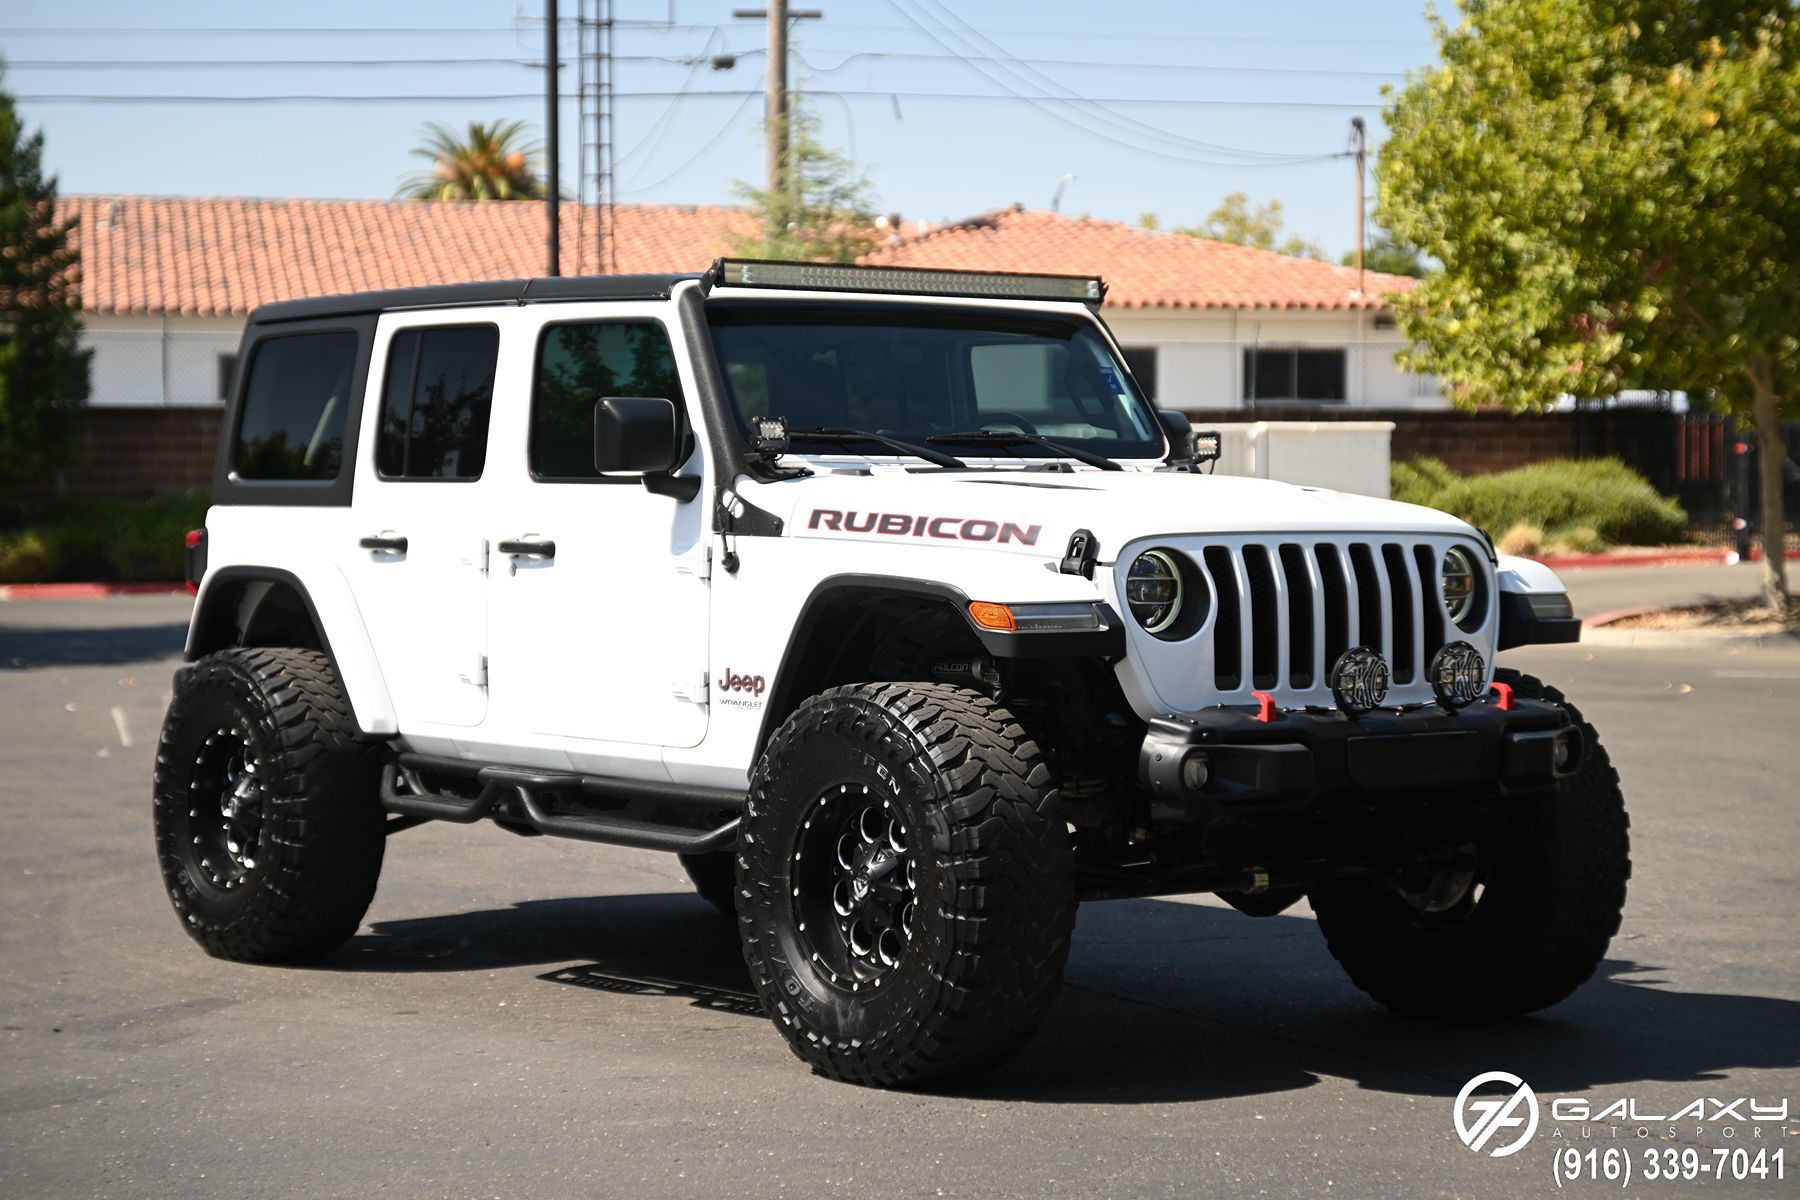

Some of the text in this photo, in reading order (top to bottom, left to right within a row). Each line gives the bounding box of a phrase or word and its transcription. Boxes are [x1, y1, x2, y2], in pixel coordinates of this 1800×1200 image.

[808, 509, 1043, 546] RUBICON
[718, 667, 766, 698] Jeep
[1354, 656, 1388, 708] KC
[1454, 651, 1485, 701] KC
[767, 928, 820, 1014] TOYO
